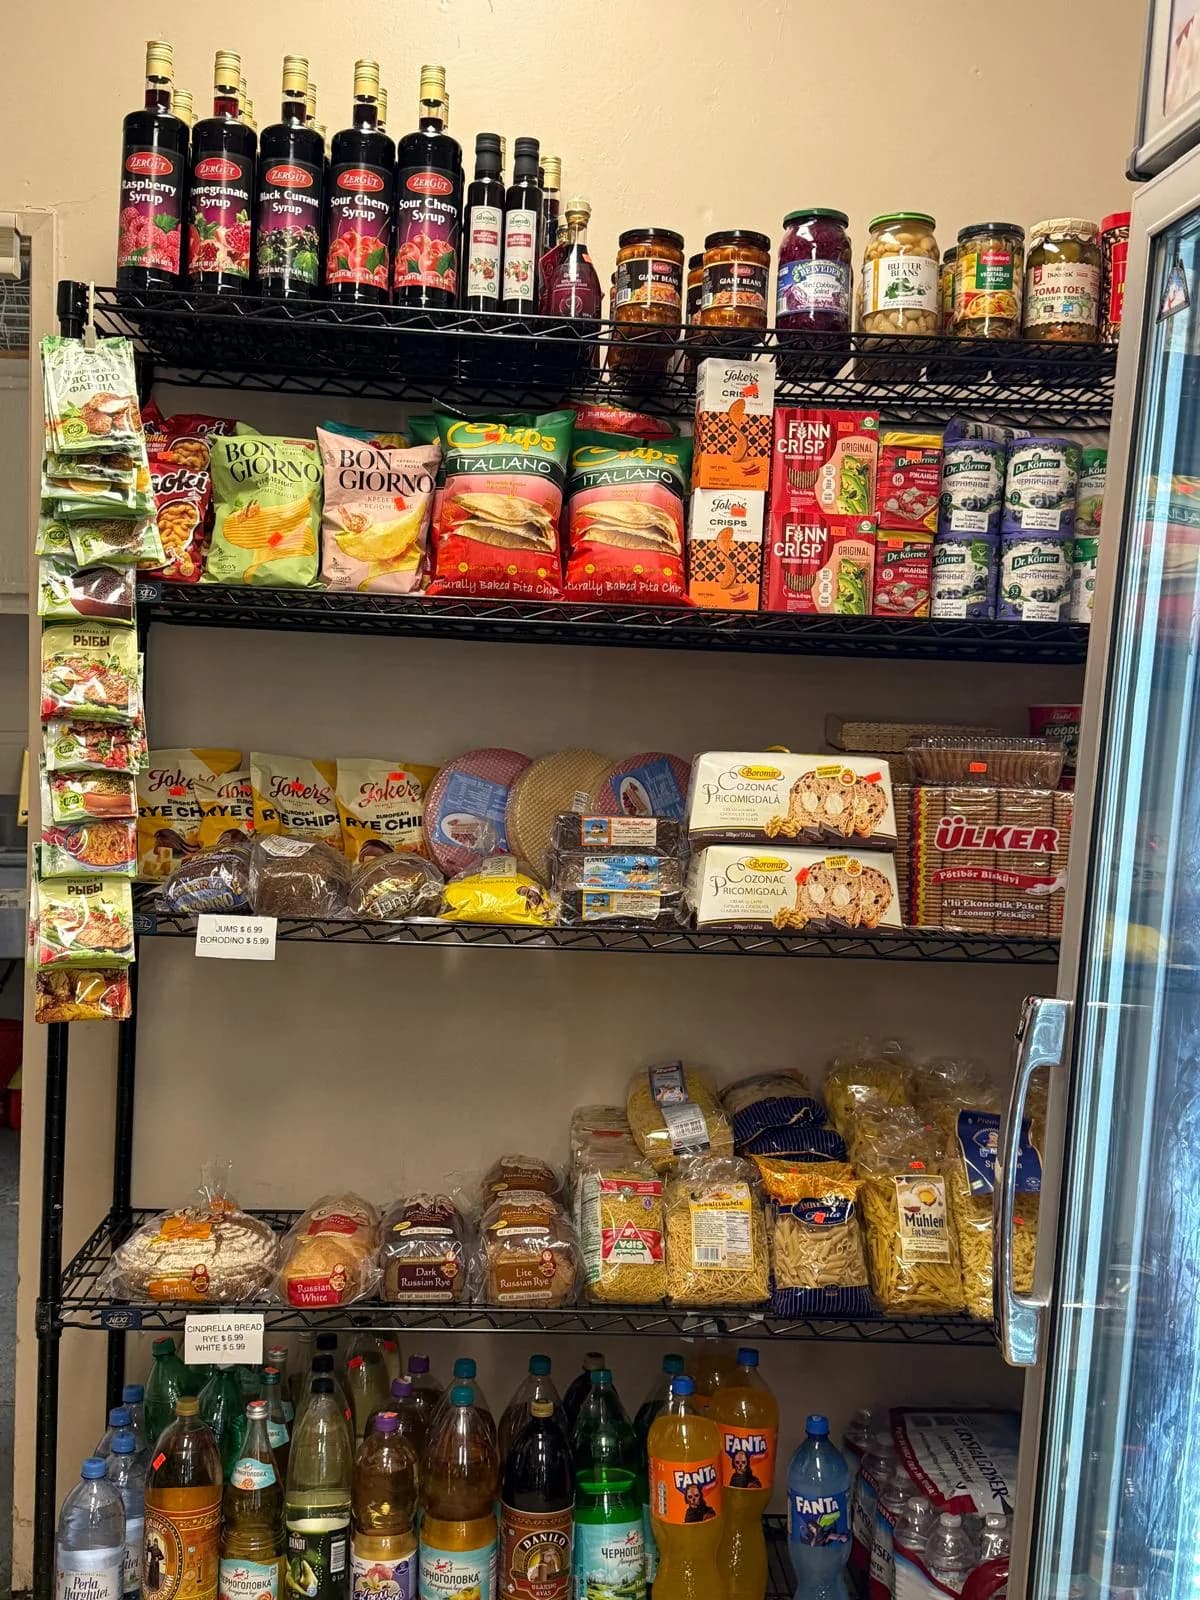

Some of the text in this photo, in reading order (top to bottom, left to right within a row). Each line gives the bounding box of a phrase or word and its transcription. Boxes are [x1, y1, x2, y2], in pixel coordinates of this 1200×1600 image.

[129, 191, 163, 206] Syrup
[200, 197, 231, 209] Syrup
[330, 196, 351, 208] Sour
[400, 198, 420, 211] Sour
[272, 202, 303, 215] Syrup
[342, 206, 375, 222] Syrup
[412, 209, 446, 225] Syrup
[719, 277, 762, 287] GIANT BEANS
[1034, 285, 1086, 297] TOMATOES
[447, 421, 557, 451] Chips
[225, 440, 277, 463] BON
[777, 438, 825, 454] CRISP
[841, 442, 873, 454] ORIGINAL
[339, 449, 392, 471] BON
[456, 456, 552, 475] ITALIANO
[1027, 460, 1059, 470] Körner
[229, 456, 322, 483] GIORNO
[959, 463, 990, 473] Körner
[338, 469, 435, 497] GIORNO
[583, 468, 673, 486] ITALIANO
[709, 519, 748, 528] CRISPS
[773, 542, 822, 558] CRISP
[838, 545, 870, 557] ORIGINAL
[901, 550, 928, 560] Körner
[935, 556, 964, 566] Körner
[1014, 556, 1058, 568] Dr. Körner
[480, 580, 510, 590] Baked
[513, 580, 533, 592] Pita
[605, 580, 637, 591] Baked
[639, 580, 659, 592] Pita
[73, 634, 110, 648] РЫБЫ
[375, 810, 410, 820] EUROPEAN
[345, 817, 382, 831] RYE
[934, 815, 1060, 853] ÜLKER
[939, 869, 1020, 885] Pötibör Bisküvi
[67, 883, 104, 896] РЫБЫ
[964, 900, 1013, 910] Ekonomik
[1016, 903, 1044, 911] Paket
[958, 910, 996, 918] Economy
[997, 911, 1035, 920] Packages
[216, 925, 238, 934] JUMS
[240, 926, 245, 934] $
[199, 936, 270, 945] BORODINO $ 5.99
[904, 1212, 944, 1228] Mühlen
[911, 1228, 924, 1237] Egg
[619, 1240, 643, 1249] SIPA
[415, 1267, 438, 1277] Dark
[515, 1268, 532, 1277] Lite
[401, 1277, 451, 1287] Russian Rye
[500, 1278, 549, 1289] Russian Rye
[162, 1284, 189, 1293] Berlin
[296, 1284, 331, 1294] Russian
[301, 1293, 328, 1303] White
[186, 1323, 262, 1334] CINDRELLA BREAD
[202, 1335, 219, 1343] RYE
[221, 1335, 226, 1343] $
[194, 1344, 221, 1352] WHITE
[223, 1344, 228, 1352] $
[725, 1433, 768, 1453] FANTA
[674, 1466, 717, 1489] FANTA
[796, 1495, 839, 1515] FANTA
[522, 1534, 566, 1550] DANILO
[72, 1576, 99, 1592] Perla
